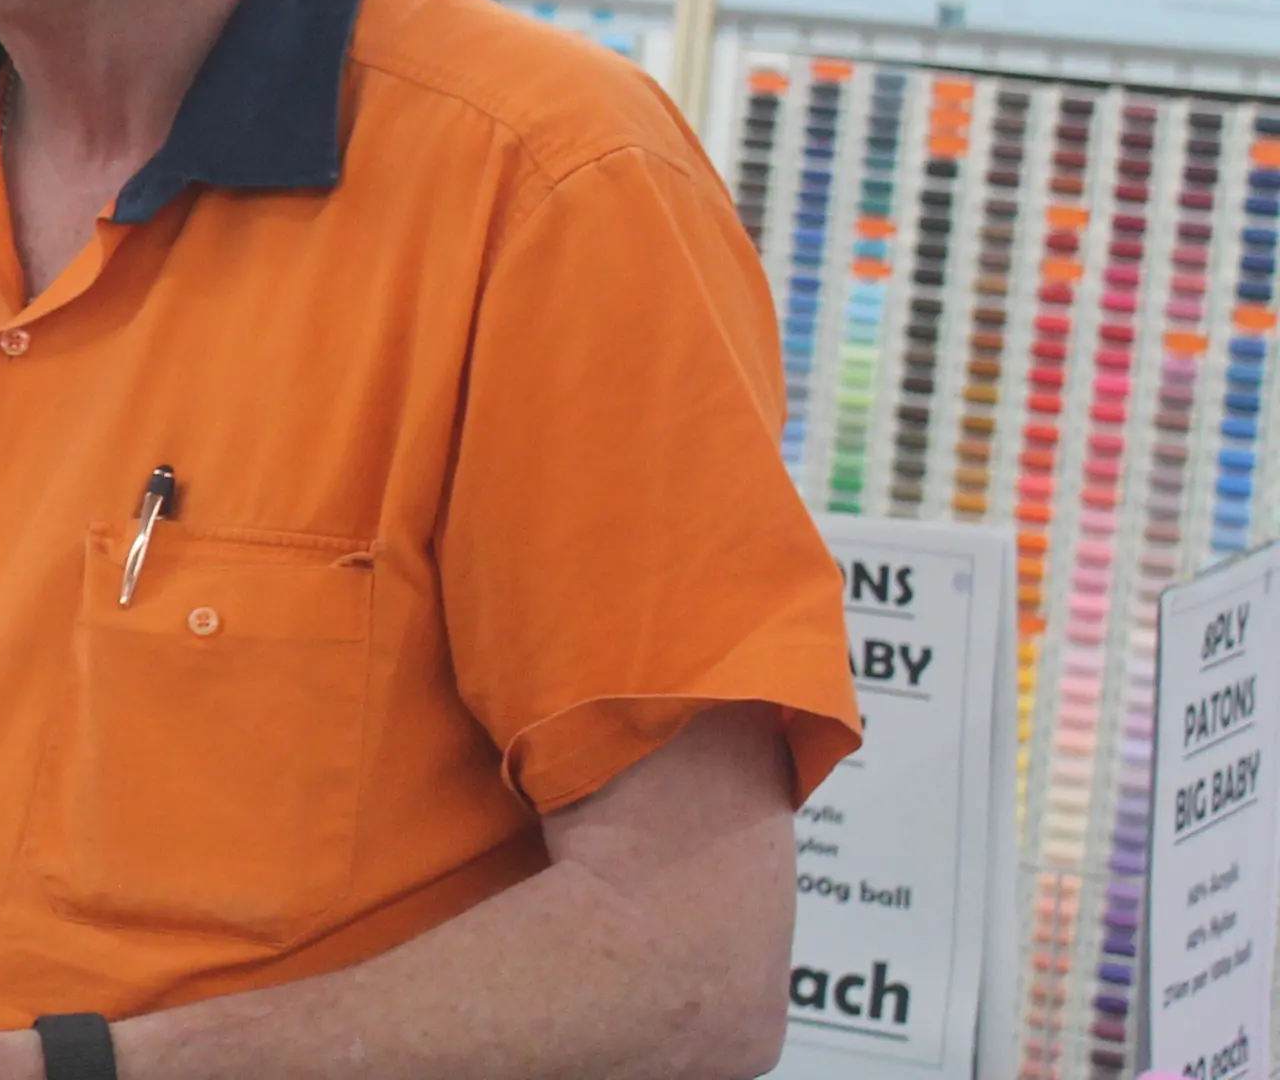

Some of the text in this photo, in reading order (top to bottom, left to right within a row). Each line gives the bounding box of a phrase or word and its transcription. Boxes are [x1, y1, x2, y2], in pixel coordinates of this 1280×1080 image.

[1200, 601, 1250, 662] 8PLY
[1183, 673, 1256, 749] PATONS
[1175, 748, 1262, 834] BIG BABY
[860, 878, 912, 912] ball
[789, 960, 910, 1025] ach
